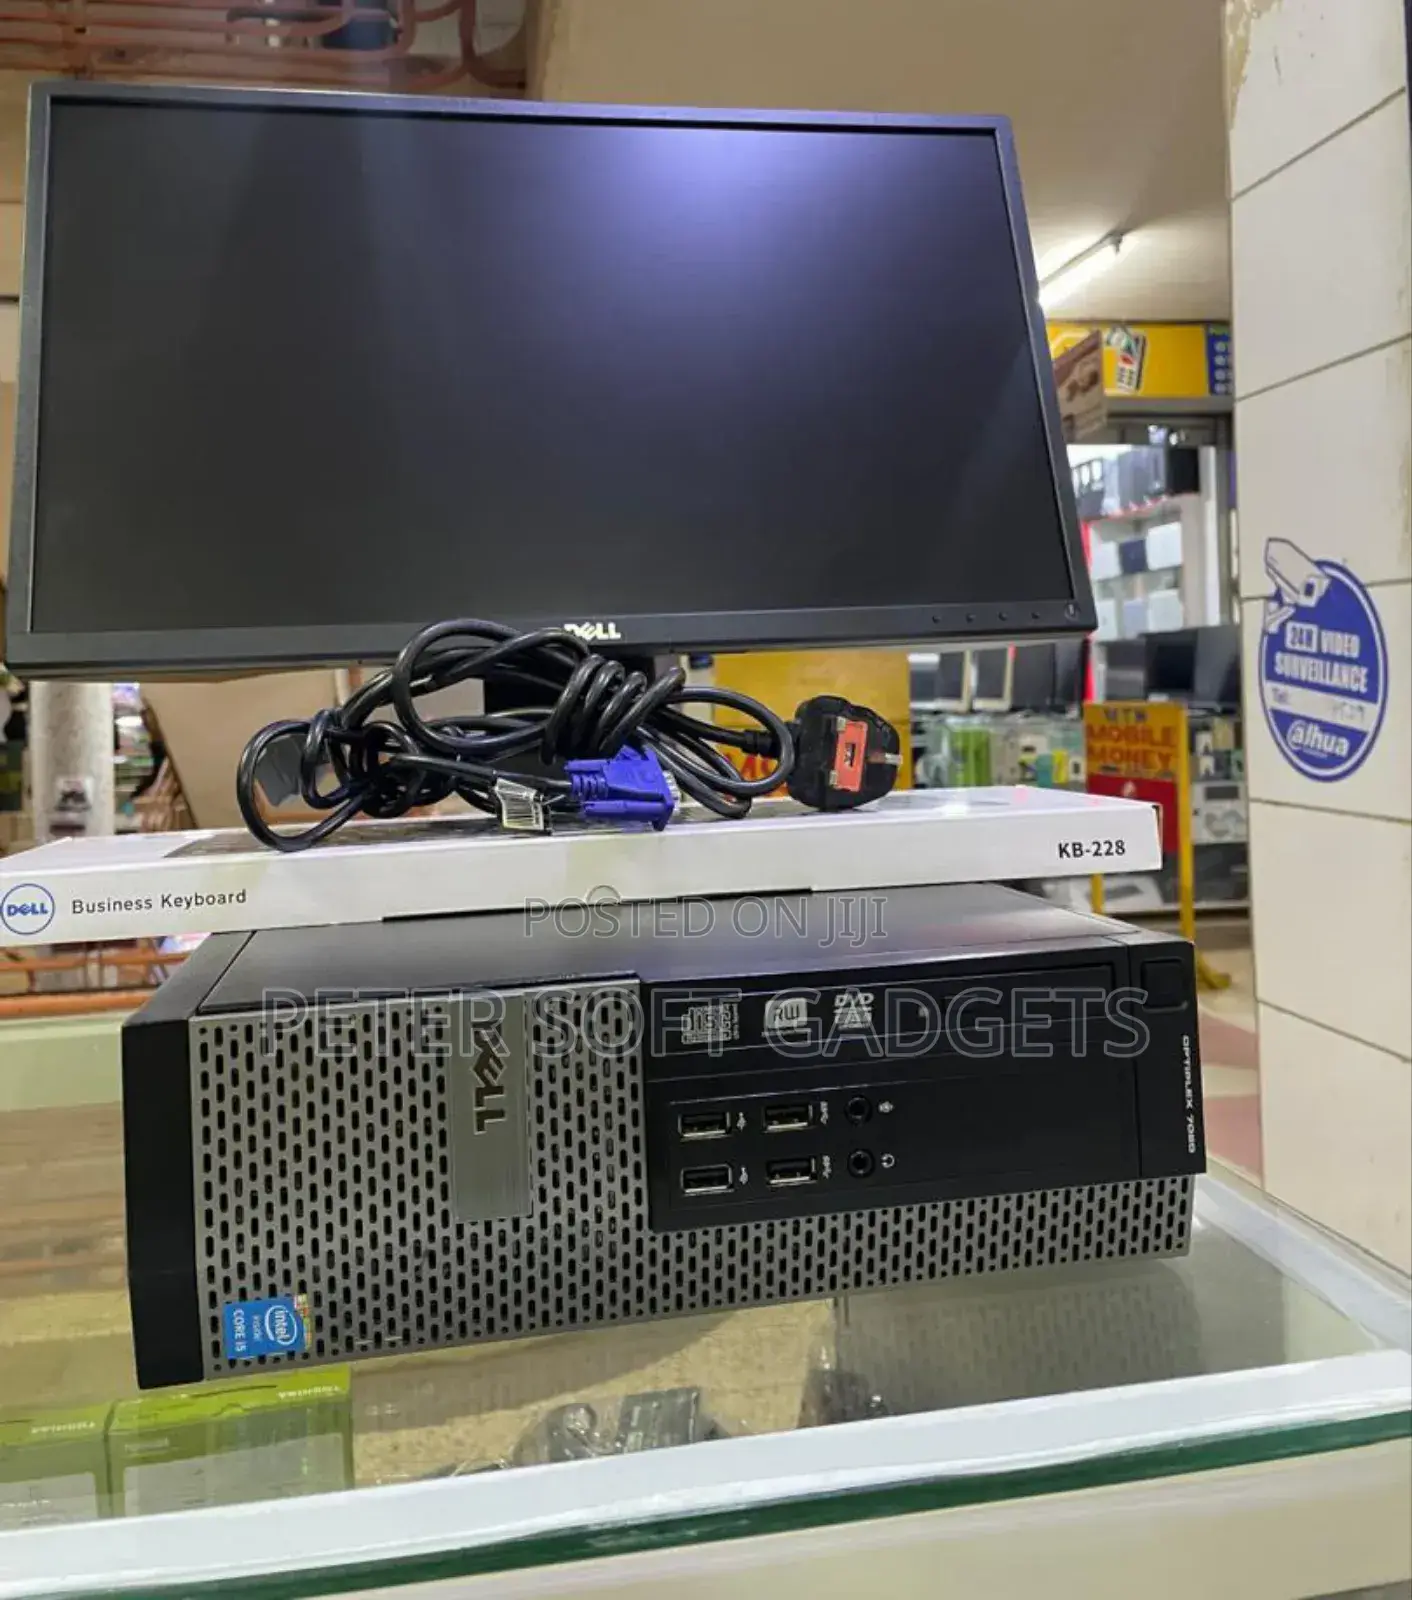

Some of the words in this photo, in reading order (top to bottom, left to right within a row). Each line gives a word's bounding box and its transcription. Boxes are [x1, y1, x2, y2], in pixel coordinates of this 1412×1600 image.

[1321, 630, 1361, 658] VIDEO
[1274, 651, 1368, 693] SURVEILLANCE
[1085, 724, 1177, 747] MOBILE
[1085, 745, 1173, 770] MONEY
[1058, 839, 1126, 858] KB-228
[6, 902, 49, 917] DELL
[72, 898, 153, 914] Business
[161, 889, 247, 910] Keyboard
[471, 1020, 507, 1135] DELL
[1182, 1034, 1193, 1110] OPTIPLEX
[233, 1308, 246, 1340] CORE
[274, 1310, 291, 1341] intel
